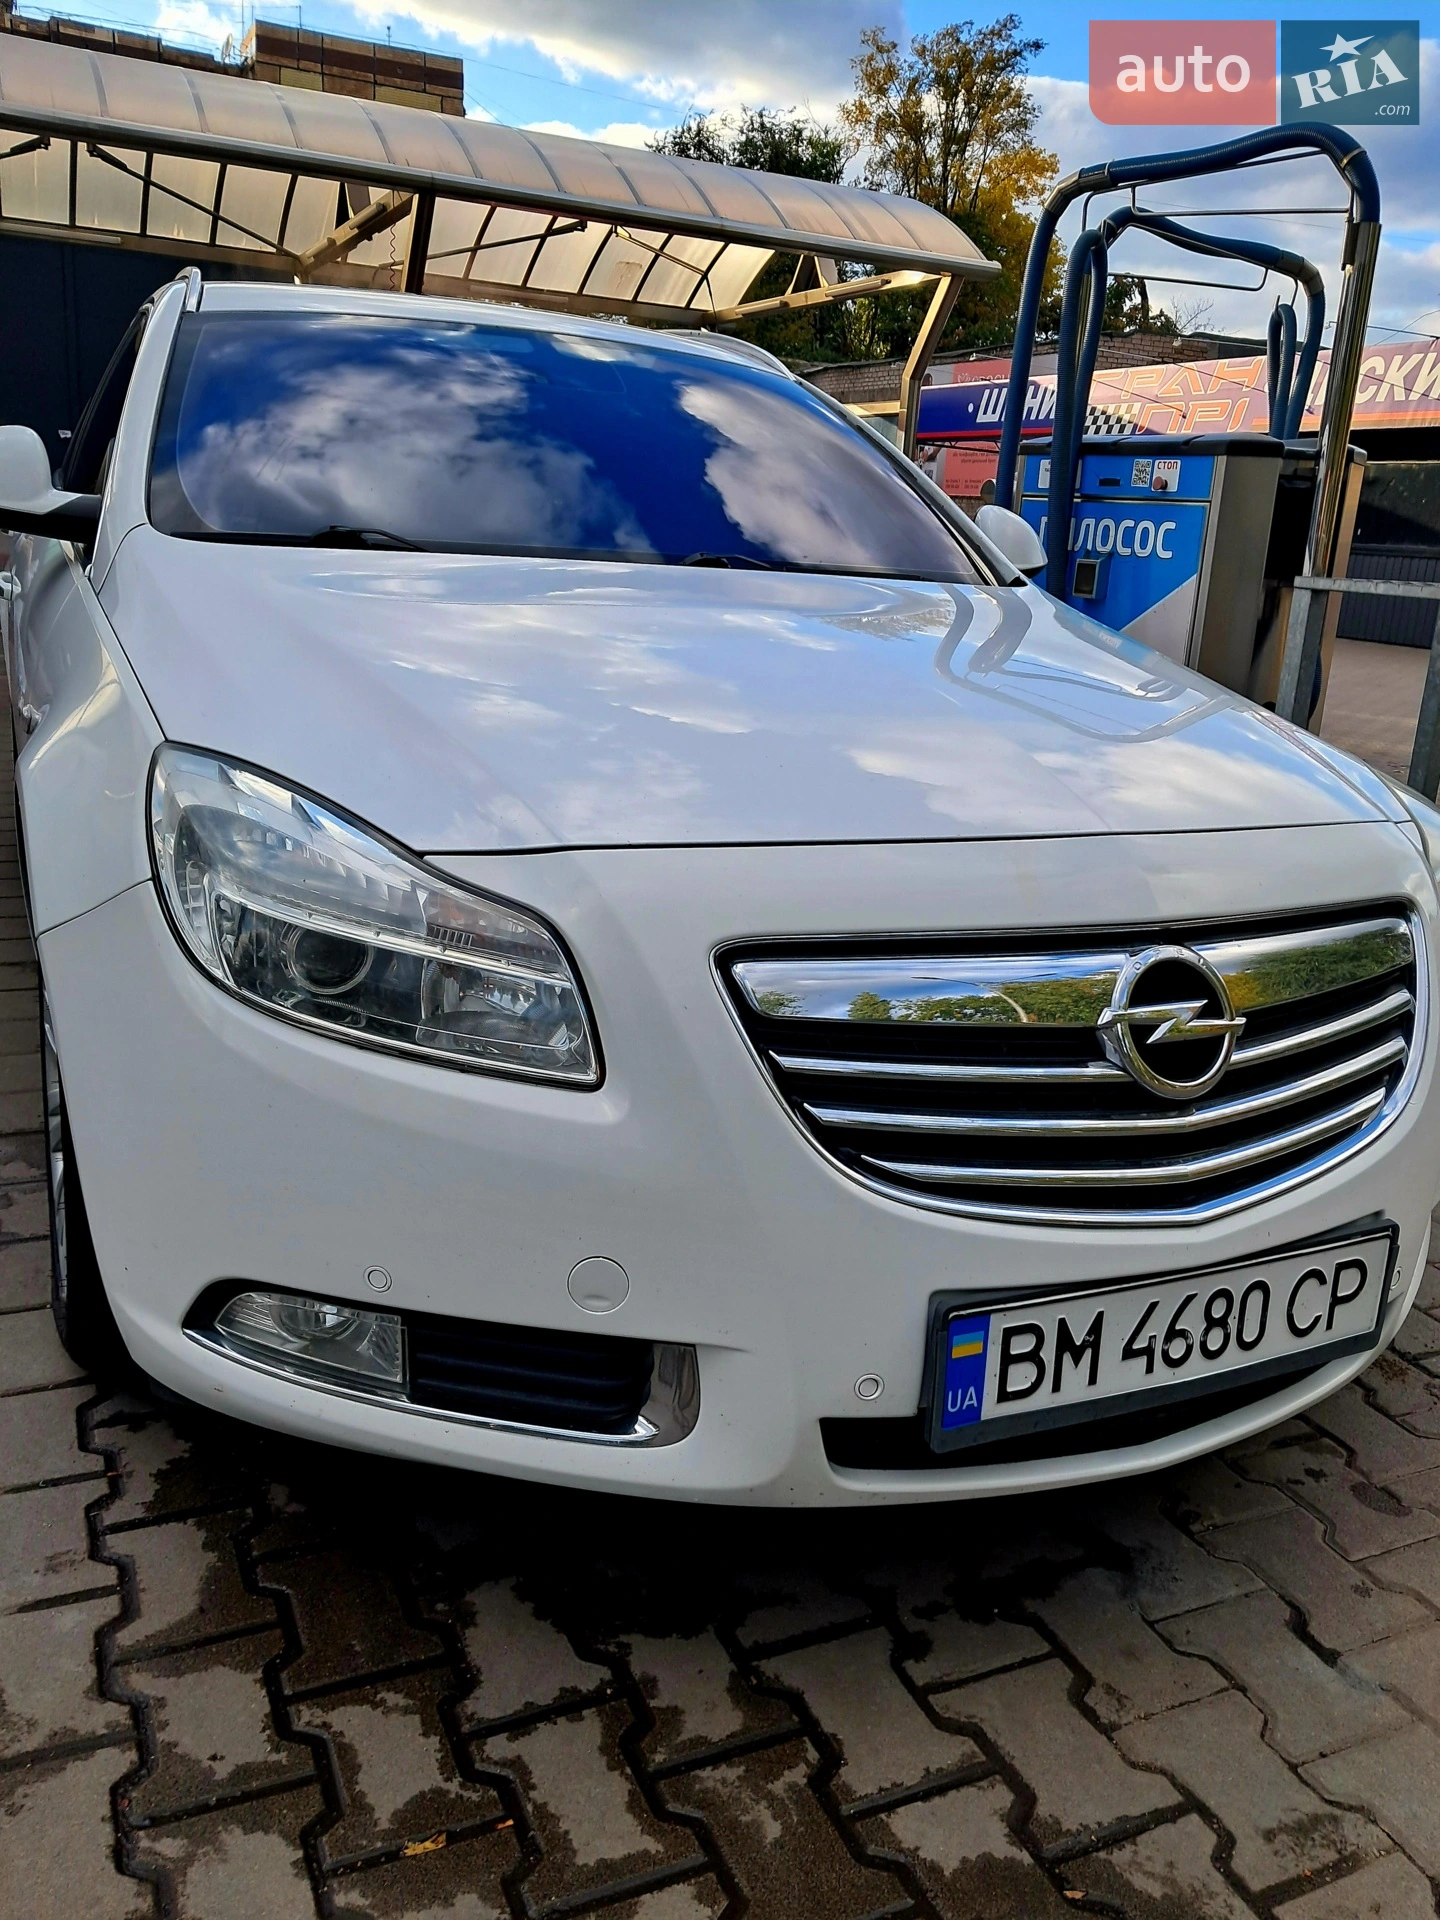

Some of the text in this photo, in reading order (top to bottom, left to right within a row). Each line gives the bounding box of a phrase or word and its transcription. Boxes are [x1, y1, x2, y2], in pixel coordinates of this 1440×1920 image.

[1157, 461, 1178, 470] СТОП
[996, 1257, 1368, 1404] BM 4680 CP
[947, 1386, 978, 1413] UA
